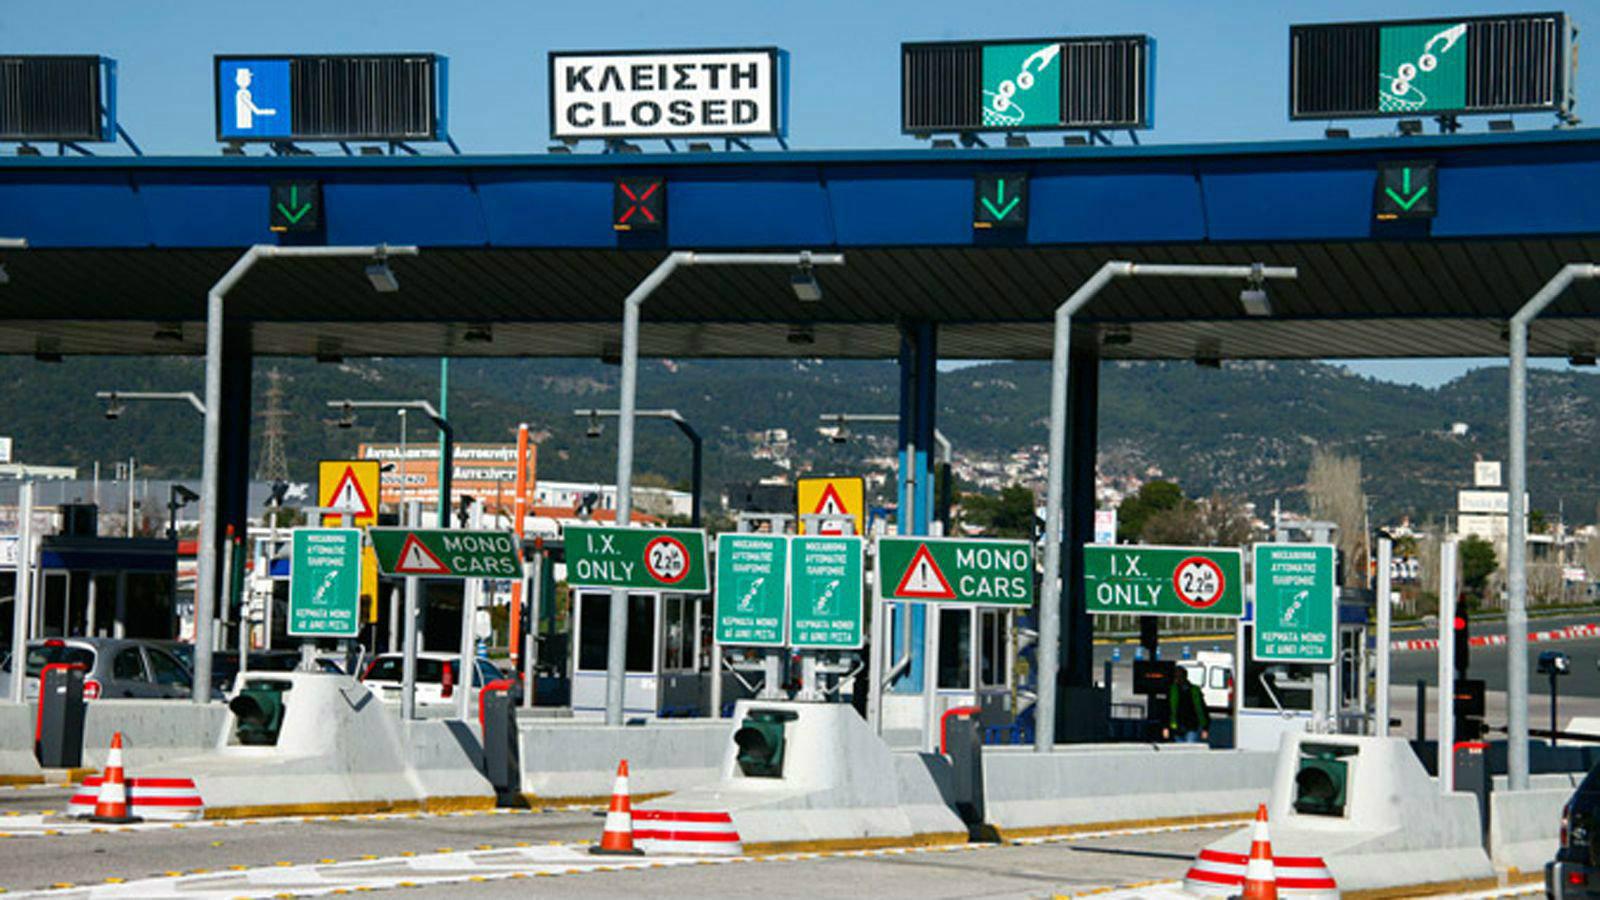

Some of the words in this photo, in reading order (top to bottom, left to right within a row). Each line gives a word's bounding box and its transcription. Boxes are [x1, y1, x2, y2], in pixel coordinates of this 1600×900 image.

[566, 63, 758, 93] ΚΛΕΙΣΤΗ
[566, 99, 759, 128] CLOSED
[442, 536, 511, 552] MONO
[452, 556, 515, 573] CARS
[577, 558, 634, 581] ONLY
[956, 548, 1028, 571] MONO
[960, 575, 1027, 598] CARS
[1097, 583, 1161, 605] ONLY
